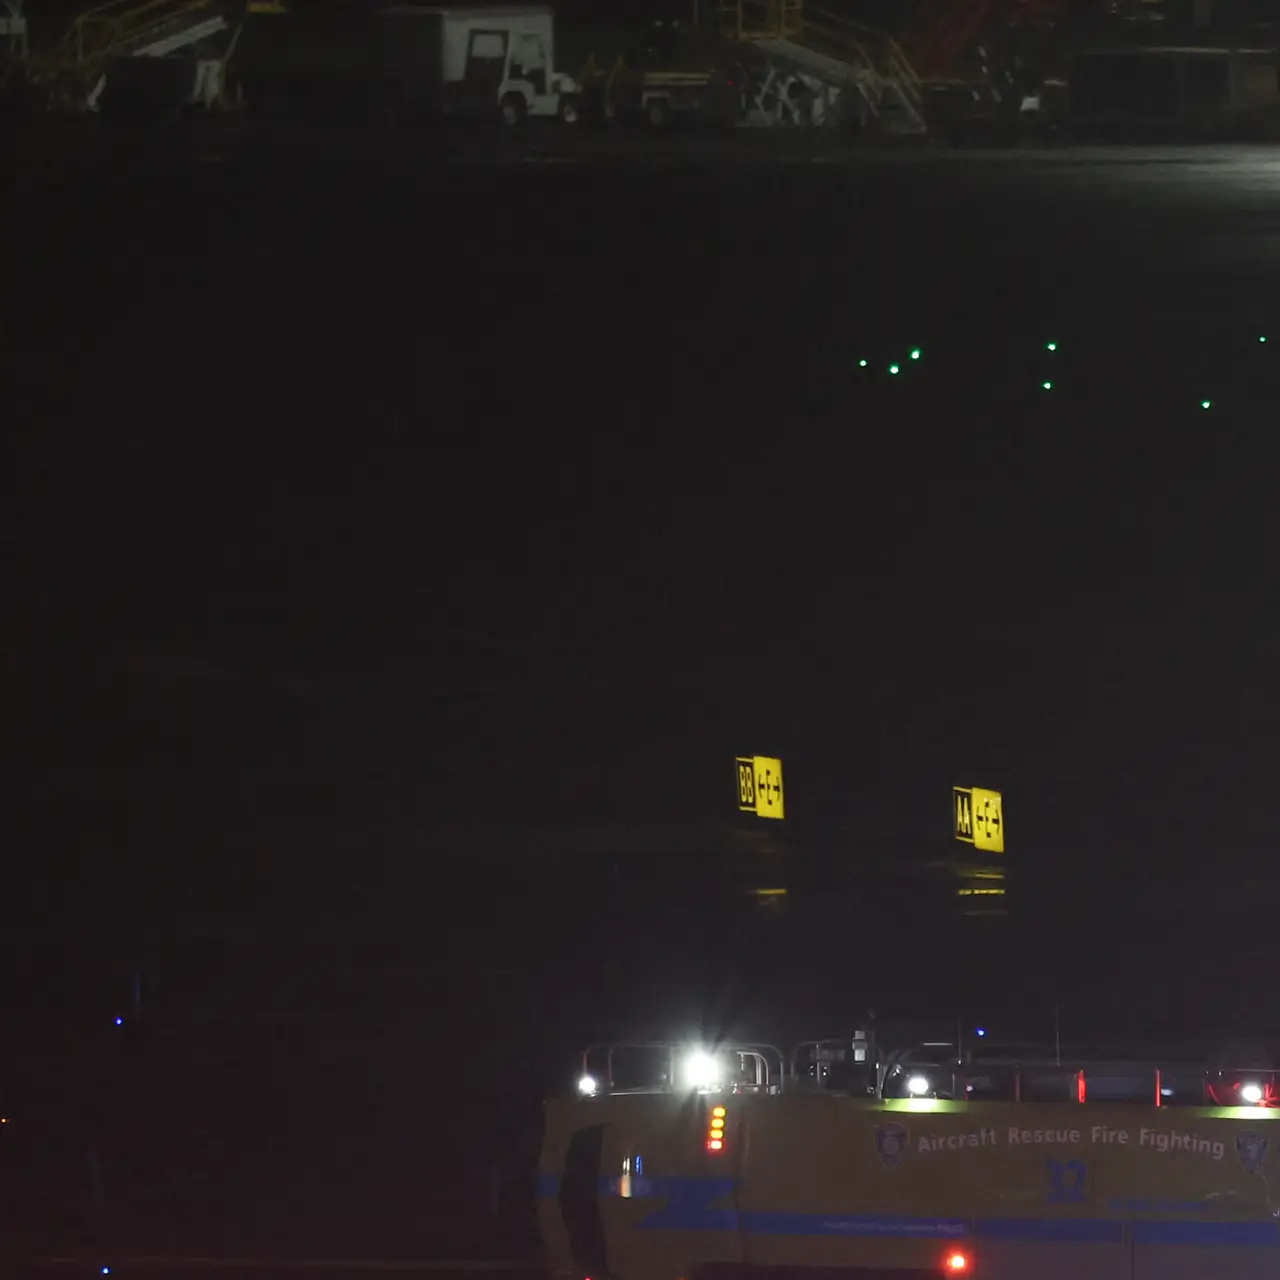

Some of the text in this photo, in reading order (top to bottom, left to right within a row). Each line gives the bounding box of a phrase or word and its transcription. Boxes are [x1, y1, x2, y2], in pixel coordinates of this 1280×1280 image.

[739, 765, 773, 806] BB E
[957, 795, 992, 838] AA E
[917, 1125, 1226, 1161] Aircraft Rescue Fire Fighting
